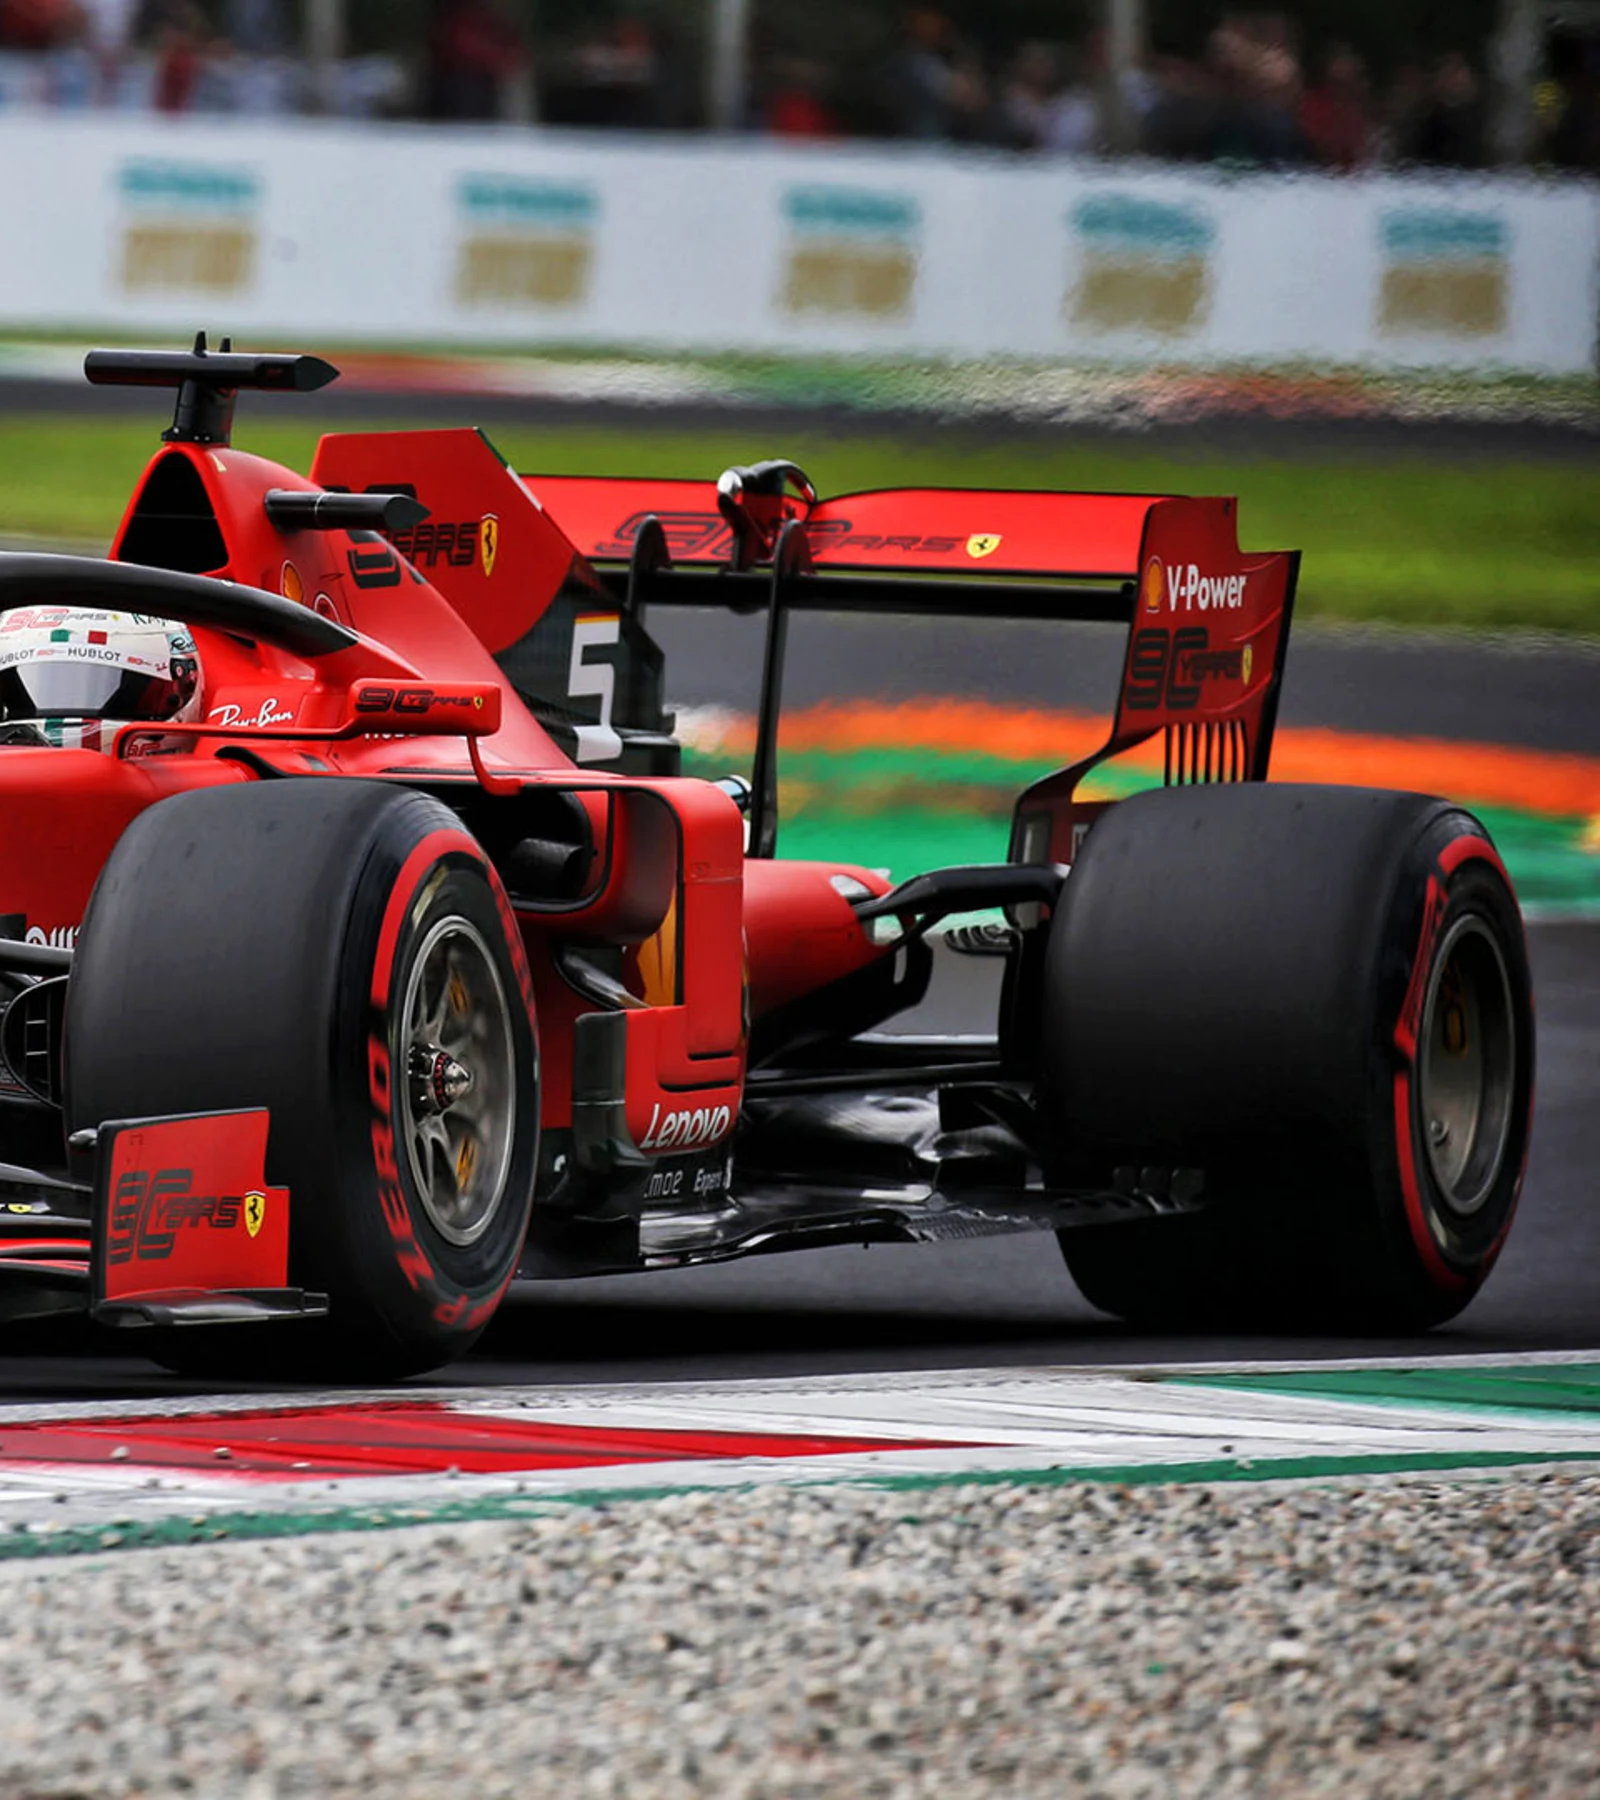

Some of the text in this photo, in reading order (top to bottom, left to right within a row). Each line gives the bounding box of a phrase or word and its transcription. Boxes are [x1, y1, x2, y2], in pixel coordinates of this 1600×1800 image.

[1167, 564, 1247, 612] V-Power
[68, 648, 121, 662] HUBLOT
[1125, 626, 1209, 711] 90
[355, 687, 434, 713] 90
[568, 610, 623, 763] 5
[640, 1103, 730, 1150] Lenovo
[108, 1168, 243, 1265] 90 YEARS
